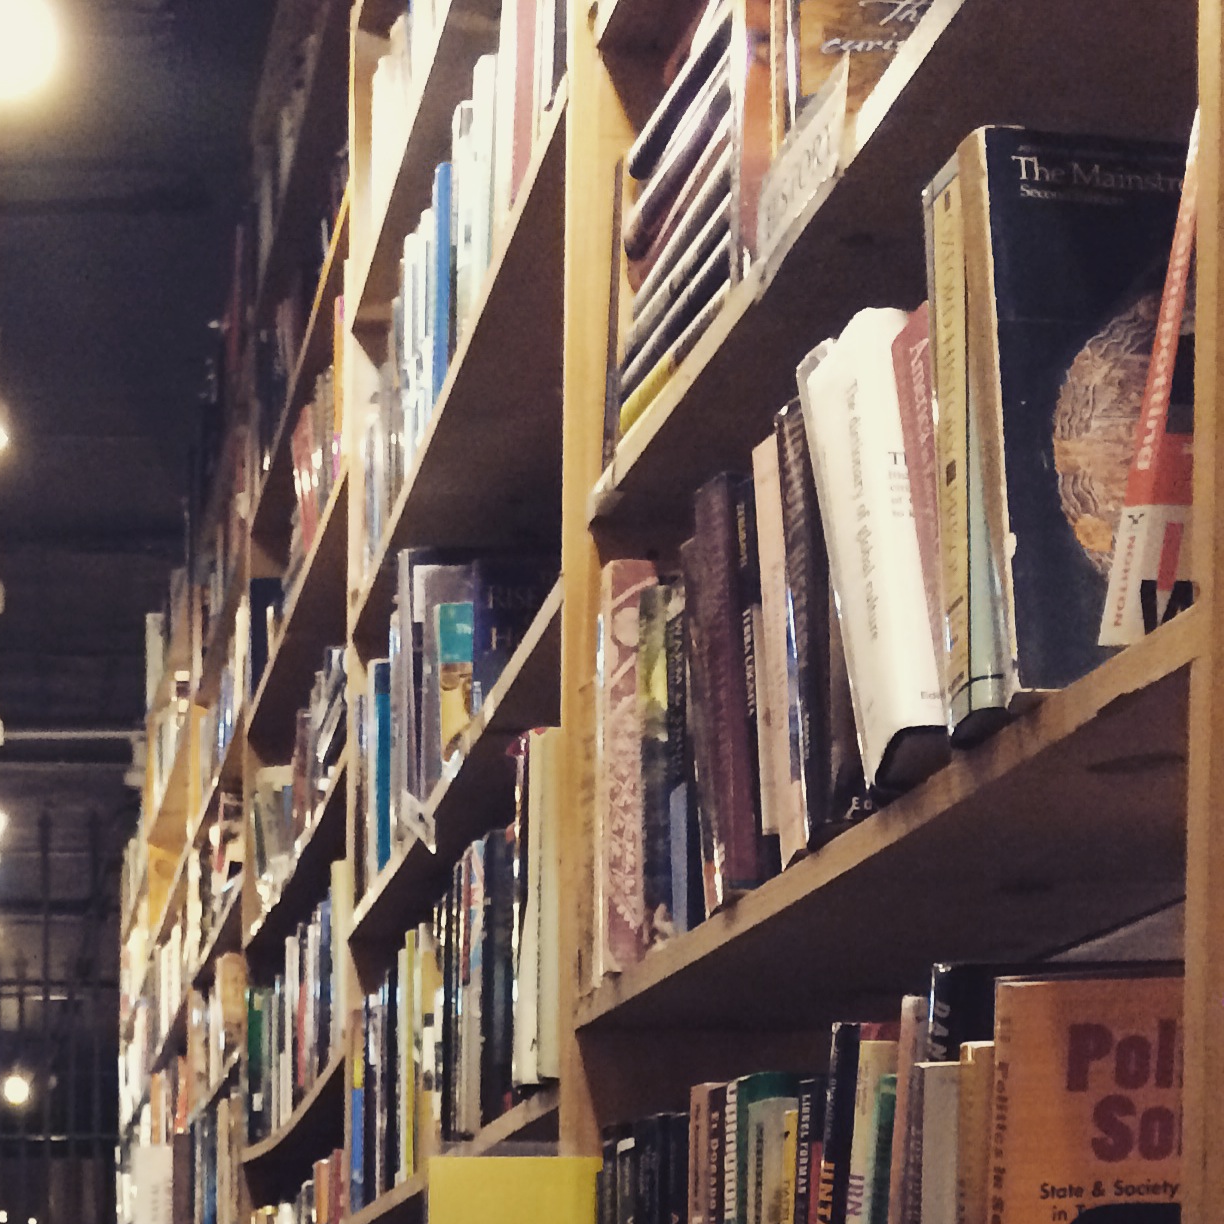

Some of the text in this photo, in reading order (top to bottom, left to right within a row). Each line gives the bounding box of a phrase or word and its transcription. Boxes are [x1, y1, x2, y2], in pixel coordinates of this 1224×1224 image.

[1012, 155, 1065, 182] The
[1113, 534, 1137, 628] NORTON
[1066, 1018, 1184, 1092] Pol
[1091, 1094, 1183, 1163] So
[846, 1174, 865, 1216] IBN
[1040, 1178, 1180, 1200] State & Society
[1051, 1206, 1068, 1222] in
